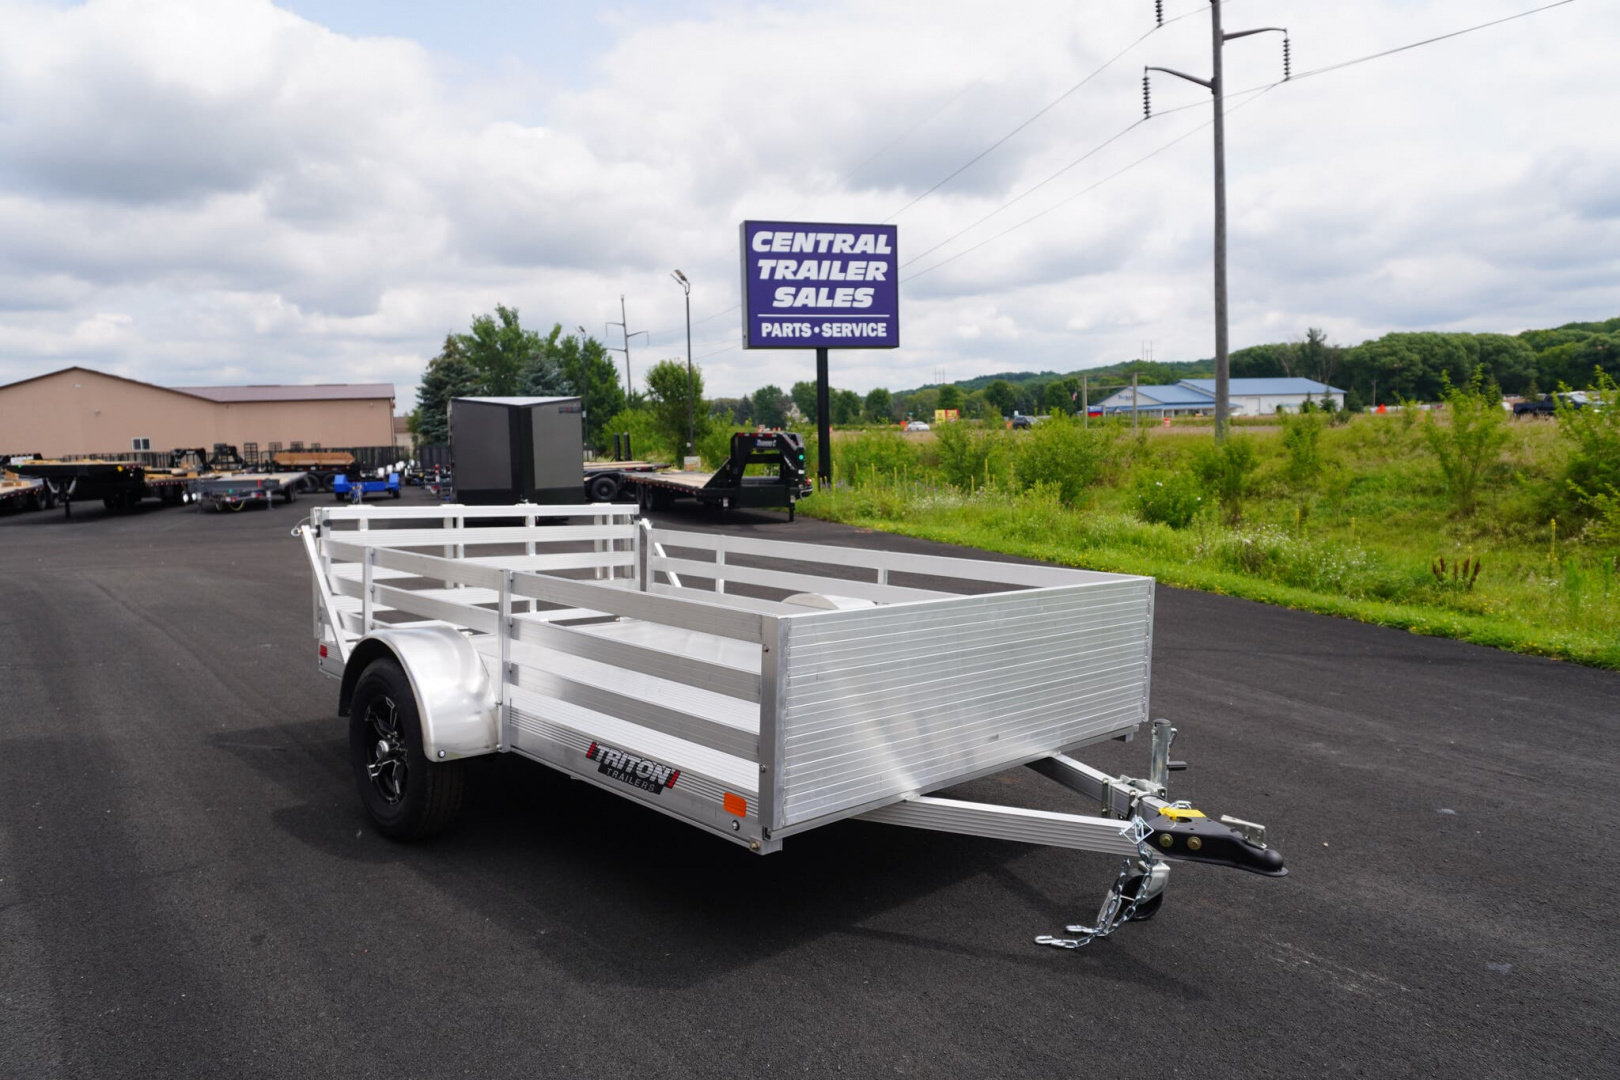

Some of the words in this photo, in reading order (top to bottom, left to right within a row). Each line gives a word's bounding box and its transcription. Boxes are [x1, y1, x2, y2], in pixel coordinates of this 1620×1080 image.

[752, 231, 891, 254] CENTRAL
[757, 259, 888, 281] TRAILER
[772, 287, 875, 308] SALES
[595, 744, 672, 785] TRITON
[606, 768, 656, 792] TRAILERS
